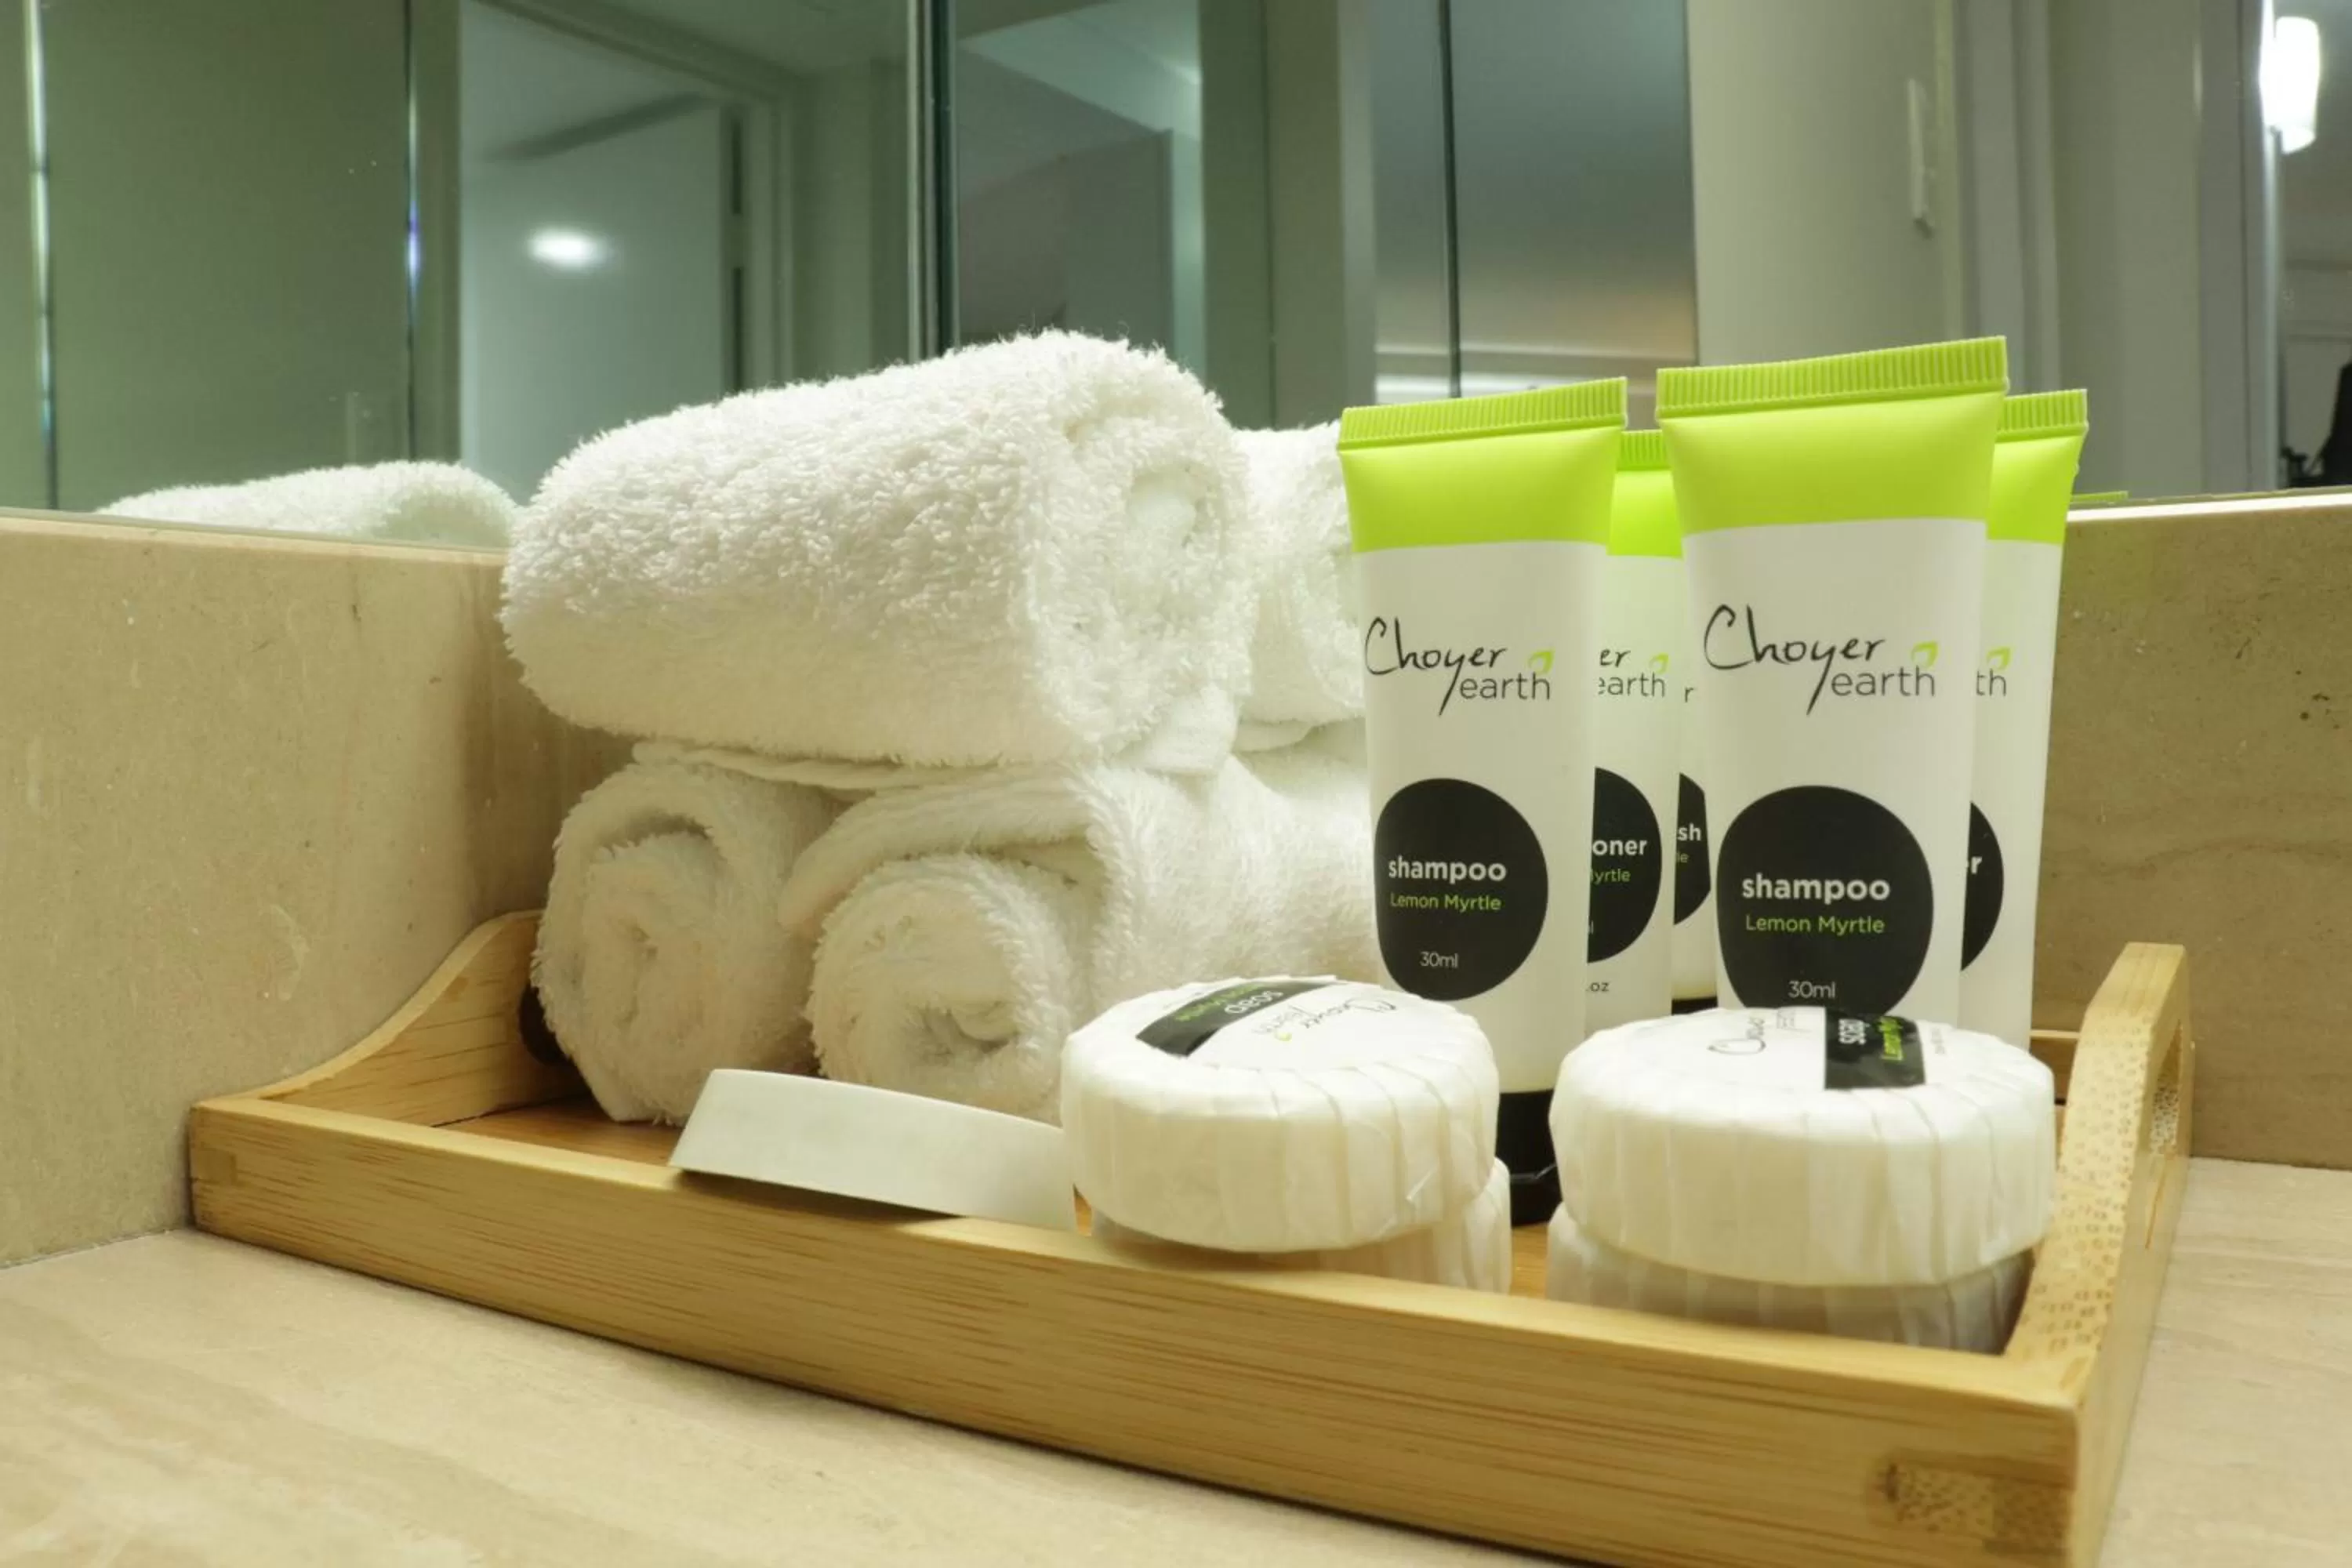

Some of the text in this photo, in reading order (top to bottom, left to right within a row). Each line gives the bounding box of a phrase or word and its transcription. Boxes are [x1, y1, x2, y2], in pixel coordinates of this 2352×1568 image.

[1364, 615, 1508, 717] Choyer
[1704, 604, 1887, 716] Choyer
[1459, 671, 1552, 700] earth
[1831, 666, 1936, 698] earth
[1388, 855, 1508, 885] shampoo
[1389, 892, 1503, 913] Lemon Myrtle
[1741, 872, 1892, 906] shampoo
[1745, 914, 1886, 937] Lemon Myrtle
[1419, 950, 1460, 968] 30ml
[1788, 980, 1837, 999] 30ml
